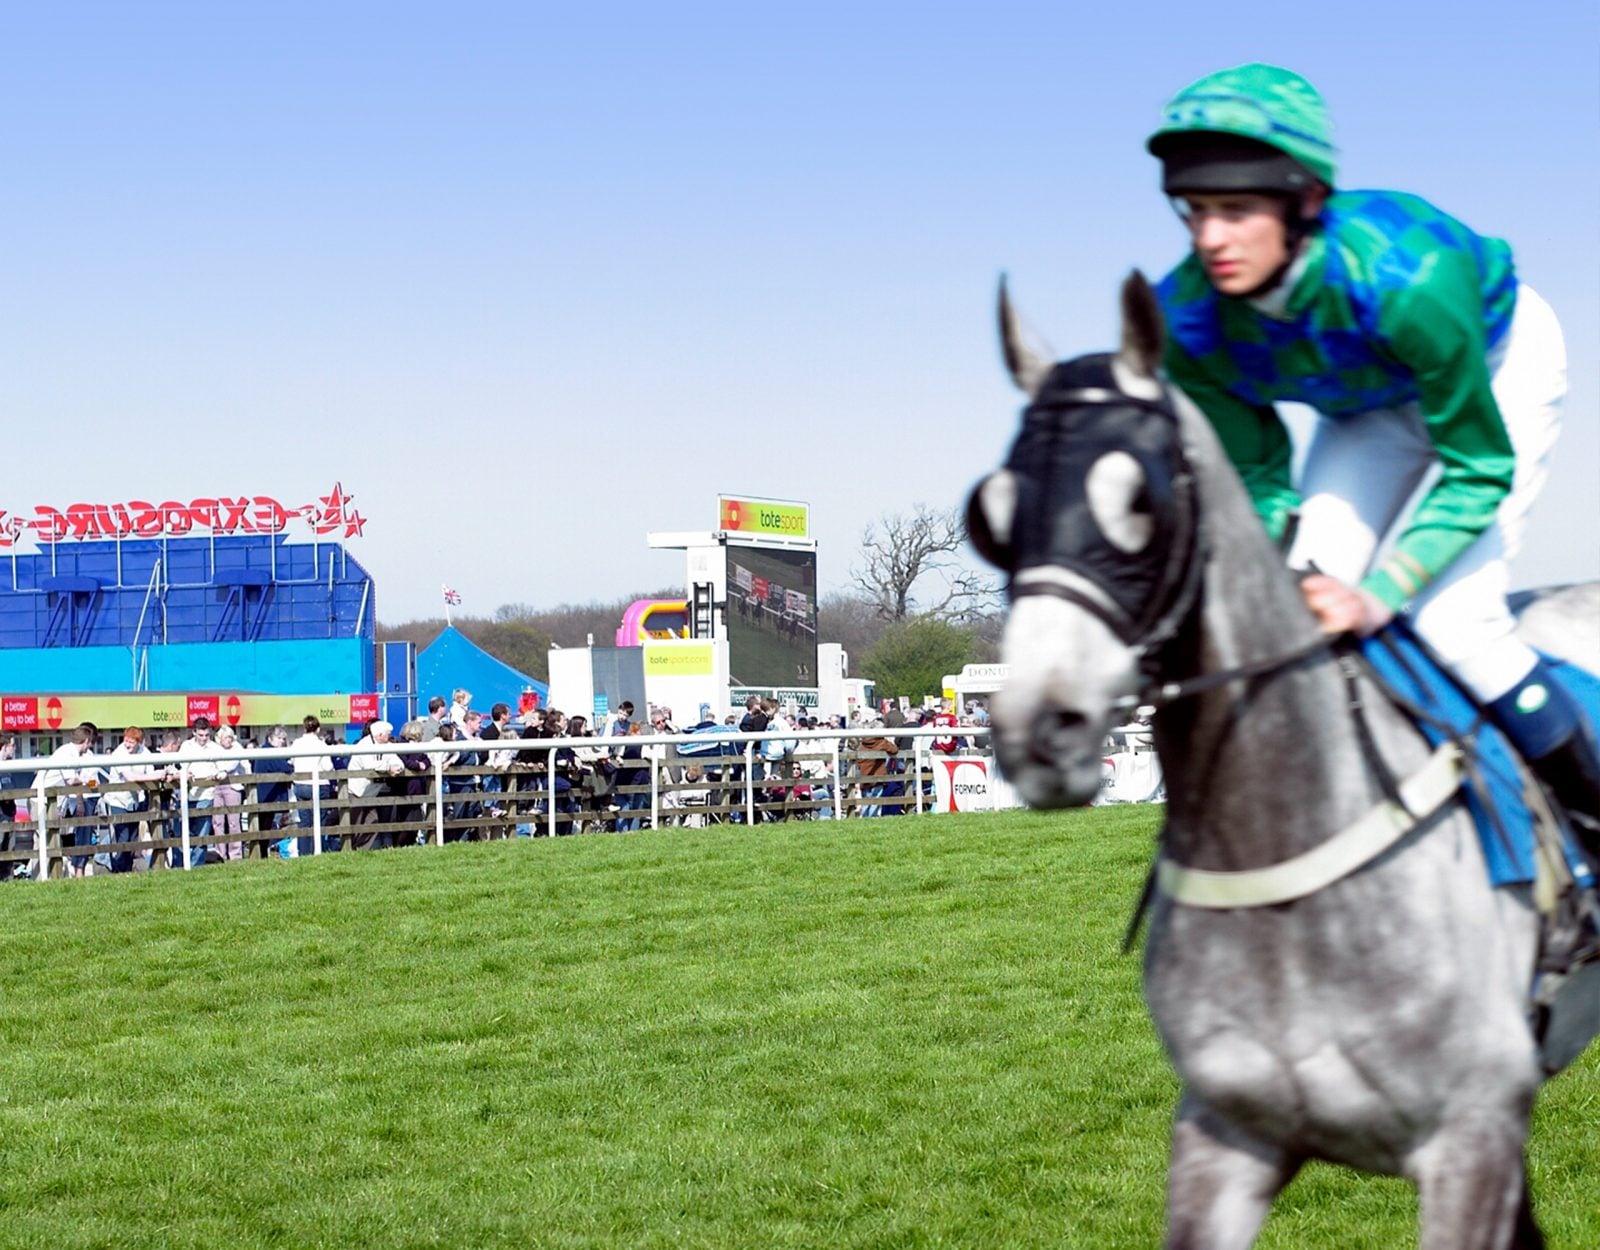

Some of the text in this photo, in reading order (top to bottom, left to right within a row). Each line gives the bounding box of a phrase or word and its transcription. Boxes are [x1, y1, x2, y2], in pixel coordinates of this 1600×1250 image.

[760, 509, 805, 533] totesport
[9, 701, 27, 711] better
[193, 700, 210, 710] better
[954, 784, 987, 794] FORMICA
